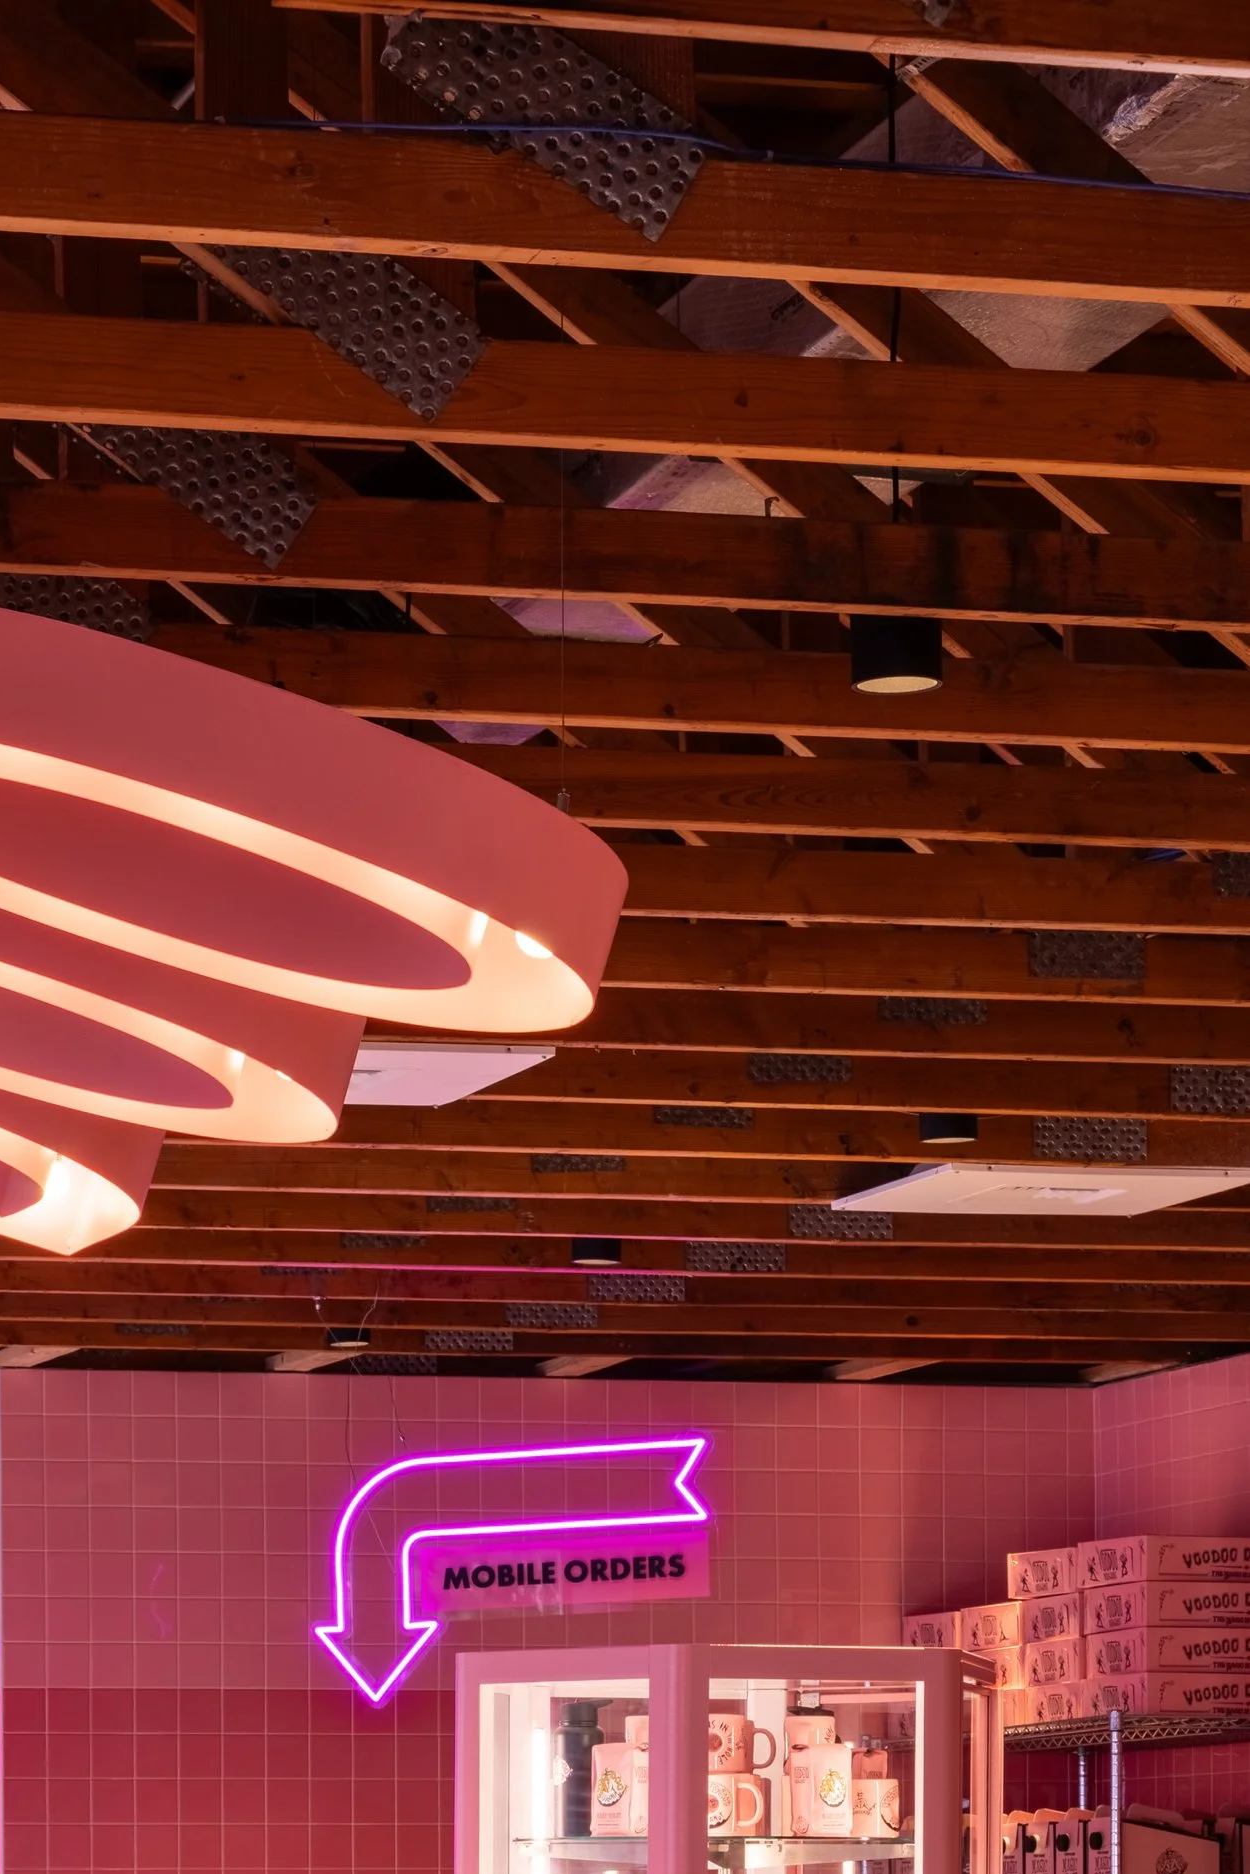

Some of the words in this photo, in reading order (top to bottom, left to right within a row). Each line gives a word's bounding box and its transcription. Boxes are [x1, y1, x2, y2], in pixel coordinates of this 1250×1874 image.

[1182, 1547, 1238, 1569] VOODOO
[443, 1561, 556, 1590] MOBILE
[563, 1554, 686, 1584] ORDERS
[1182, 1592, 1239, 1615] VOODOO
[1182, 1638, 1239, 1661] VOODOO
[1182, 1684, 1239, 1706] VOODOO
